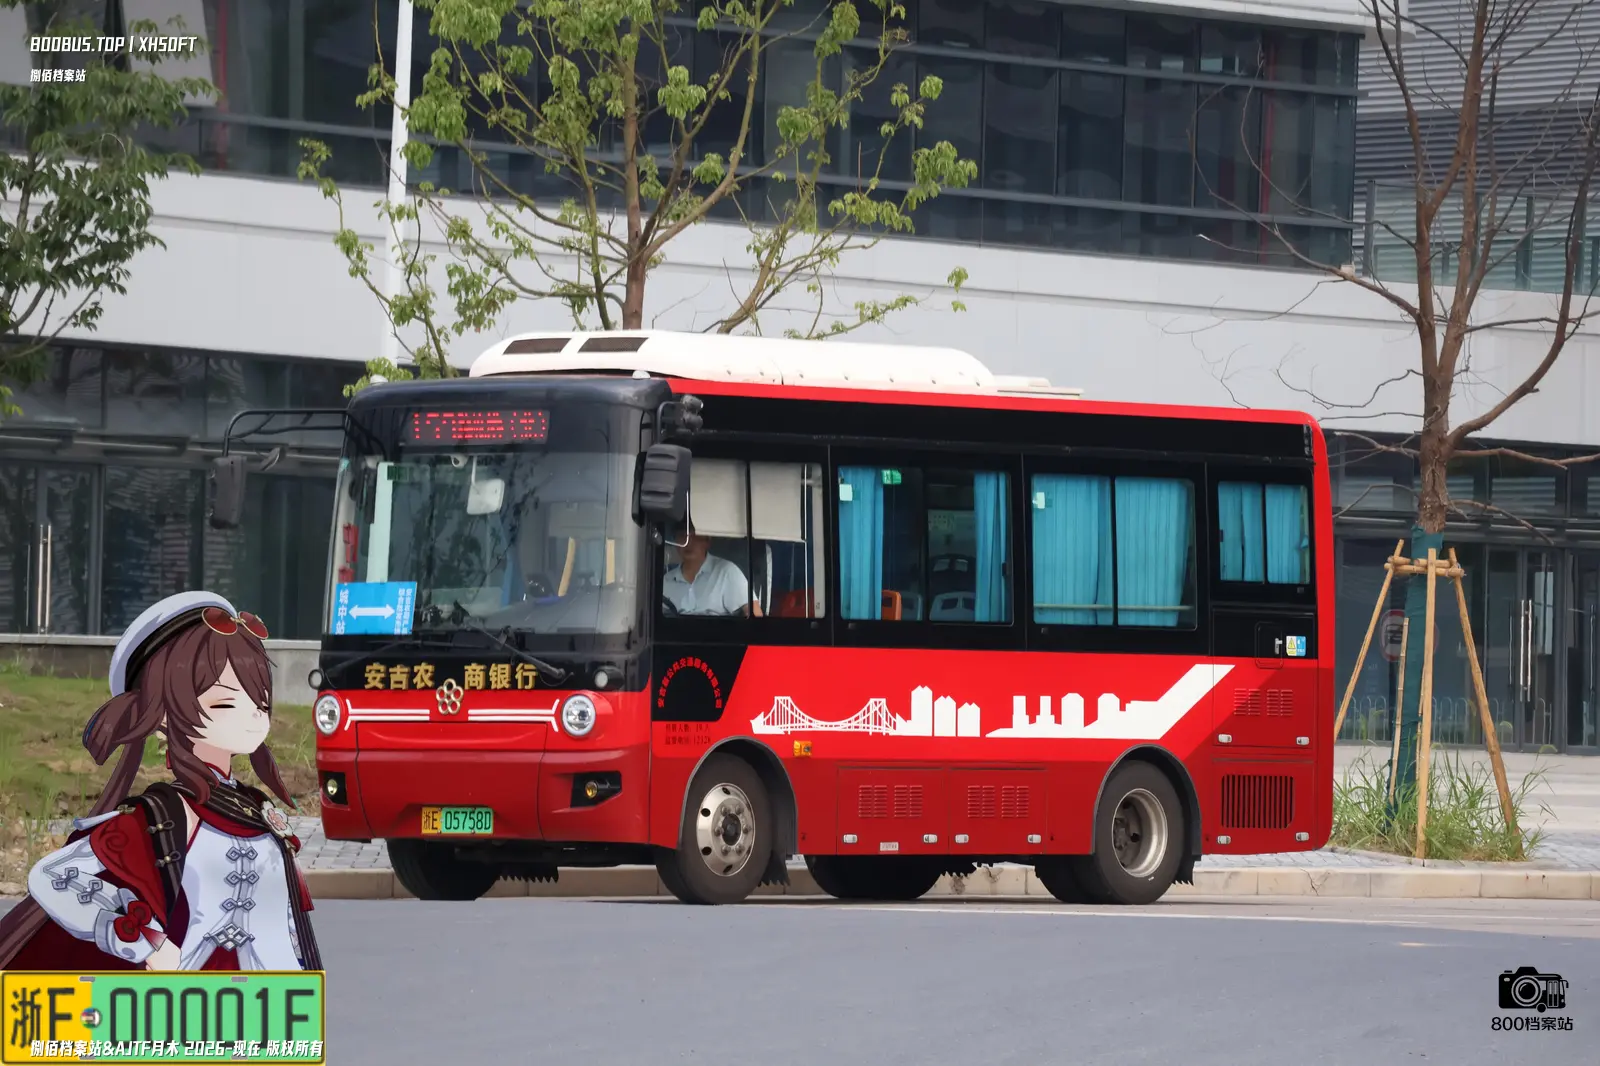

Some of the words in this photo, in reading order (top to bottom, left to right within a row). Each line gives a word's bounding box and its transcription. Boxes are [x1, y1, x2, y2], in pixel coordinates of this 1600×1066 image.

[364, 662, 435, 690] 安吉农
[464, 663, 538, 690] 商银行
[445, 811, 492, 830] 05758D
